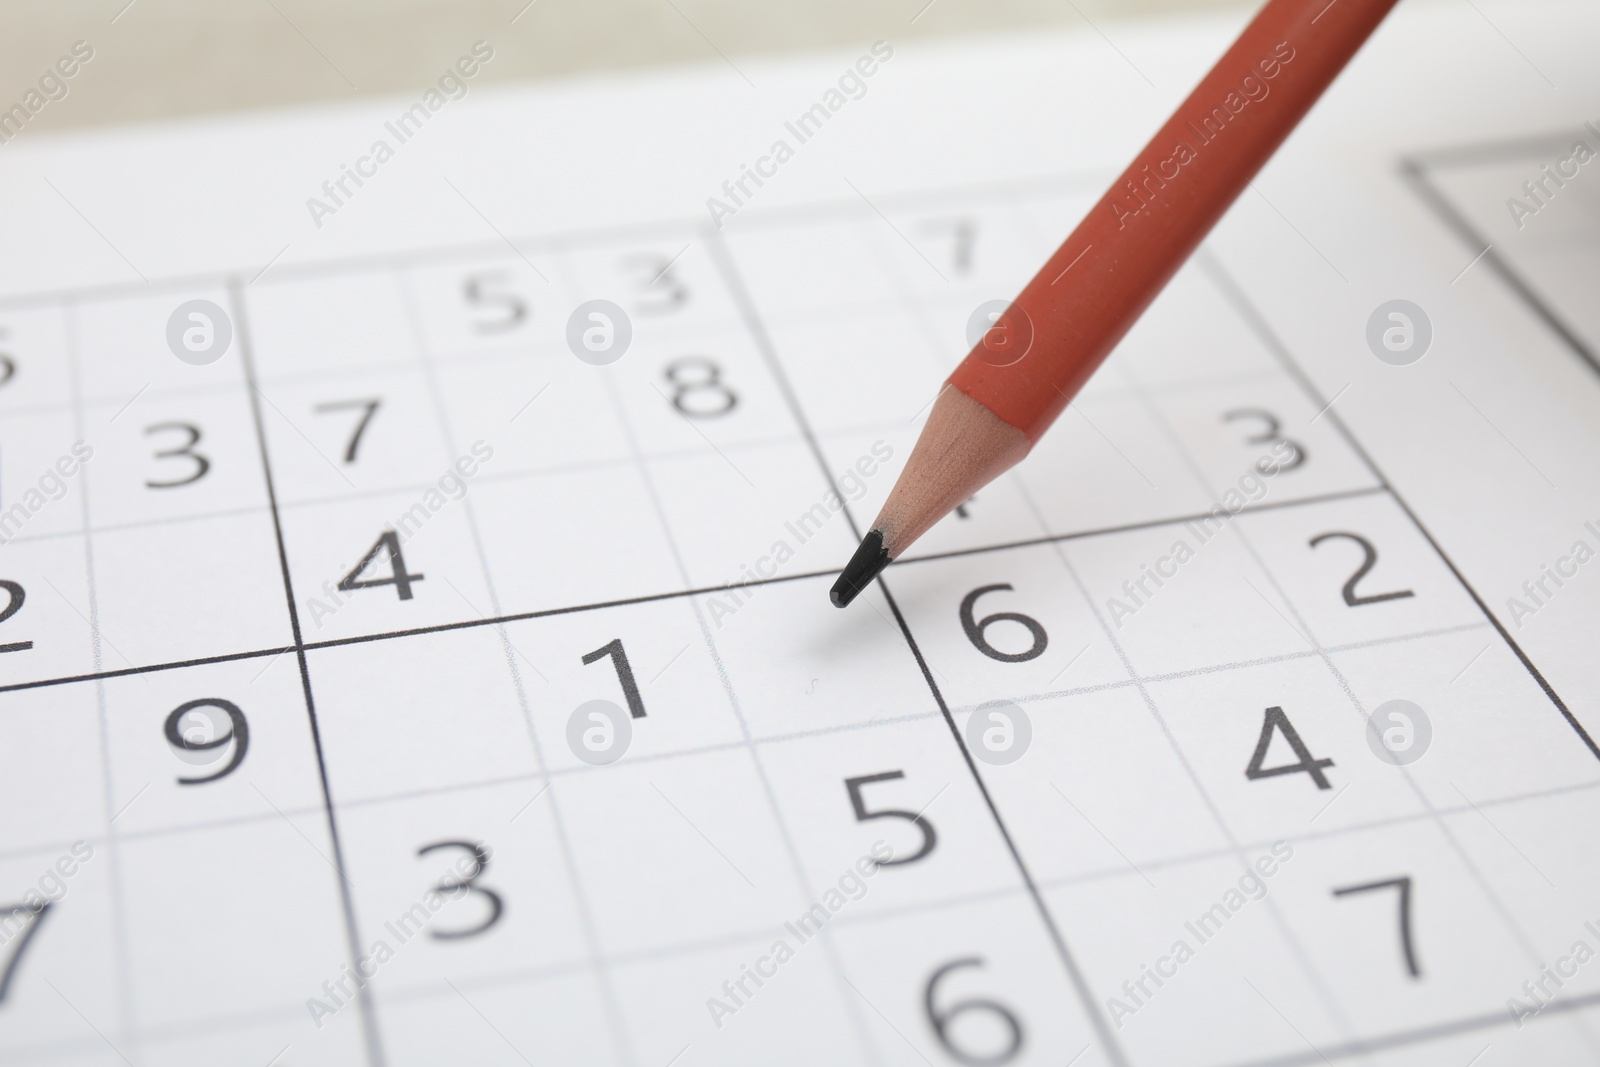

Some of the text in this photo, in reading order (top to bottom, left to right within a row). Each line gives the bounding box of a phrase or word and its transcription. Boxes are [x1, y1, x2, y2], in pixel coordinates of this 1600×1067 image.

[463, 271, 531, 335] 5
[618, 254, 692, 316] 3
[663, 355, 741, 420] 8
[144, 421, 212, 490] 3
[312, 397, 382, 466] 7
[1222, 408, 1309, 477] 3
[337, 529, 425, 602] 4
[1308, 530, 1416, 607] 2
[959, 583, 1048, 663] 6
[581, 638, 648, 720] 1
[163, 698, 250, 786] 9
[1244, 705, 1336, 791] 4
[843, 769, 938, 868] 5
[414, 839, 505, 942] 3
[1331, 875, 1423, 980] 7
[921, 956, 1027, 1067] 6
